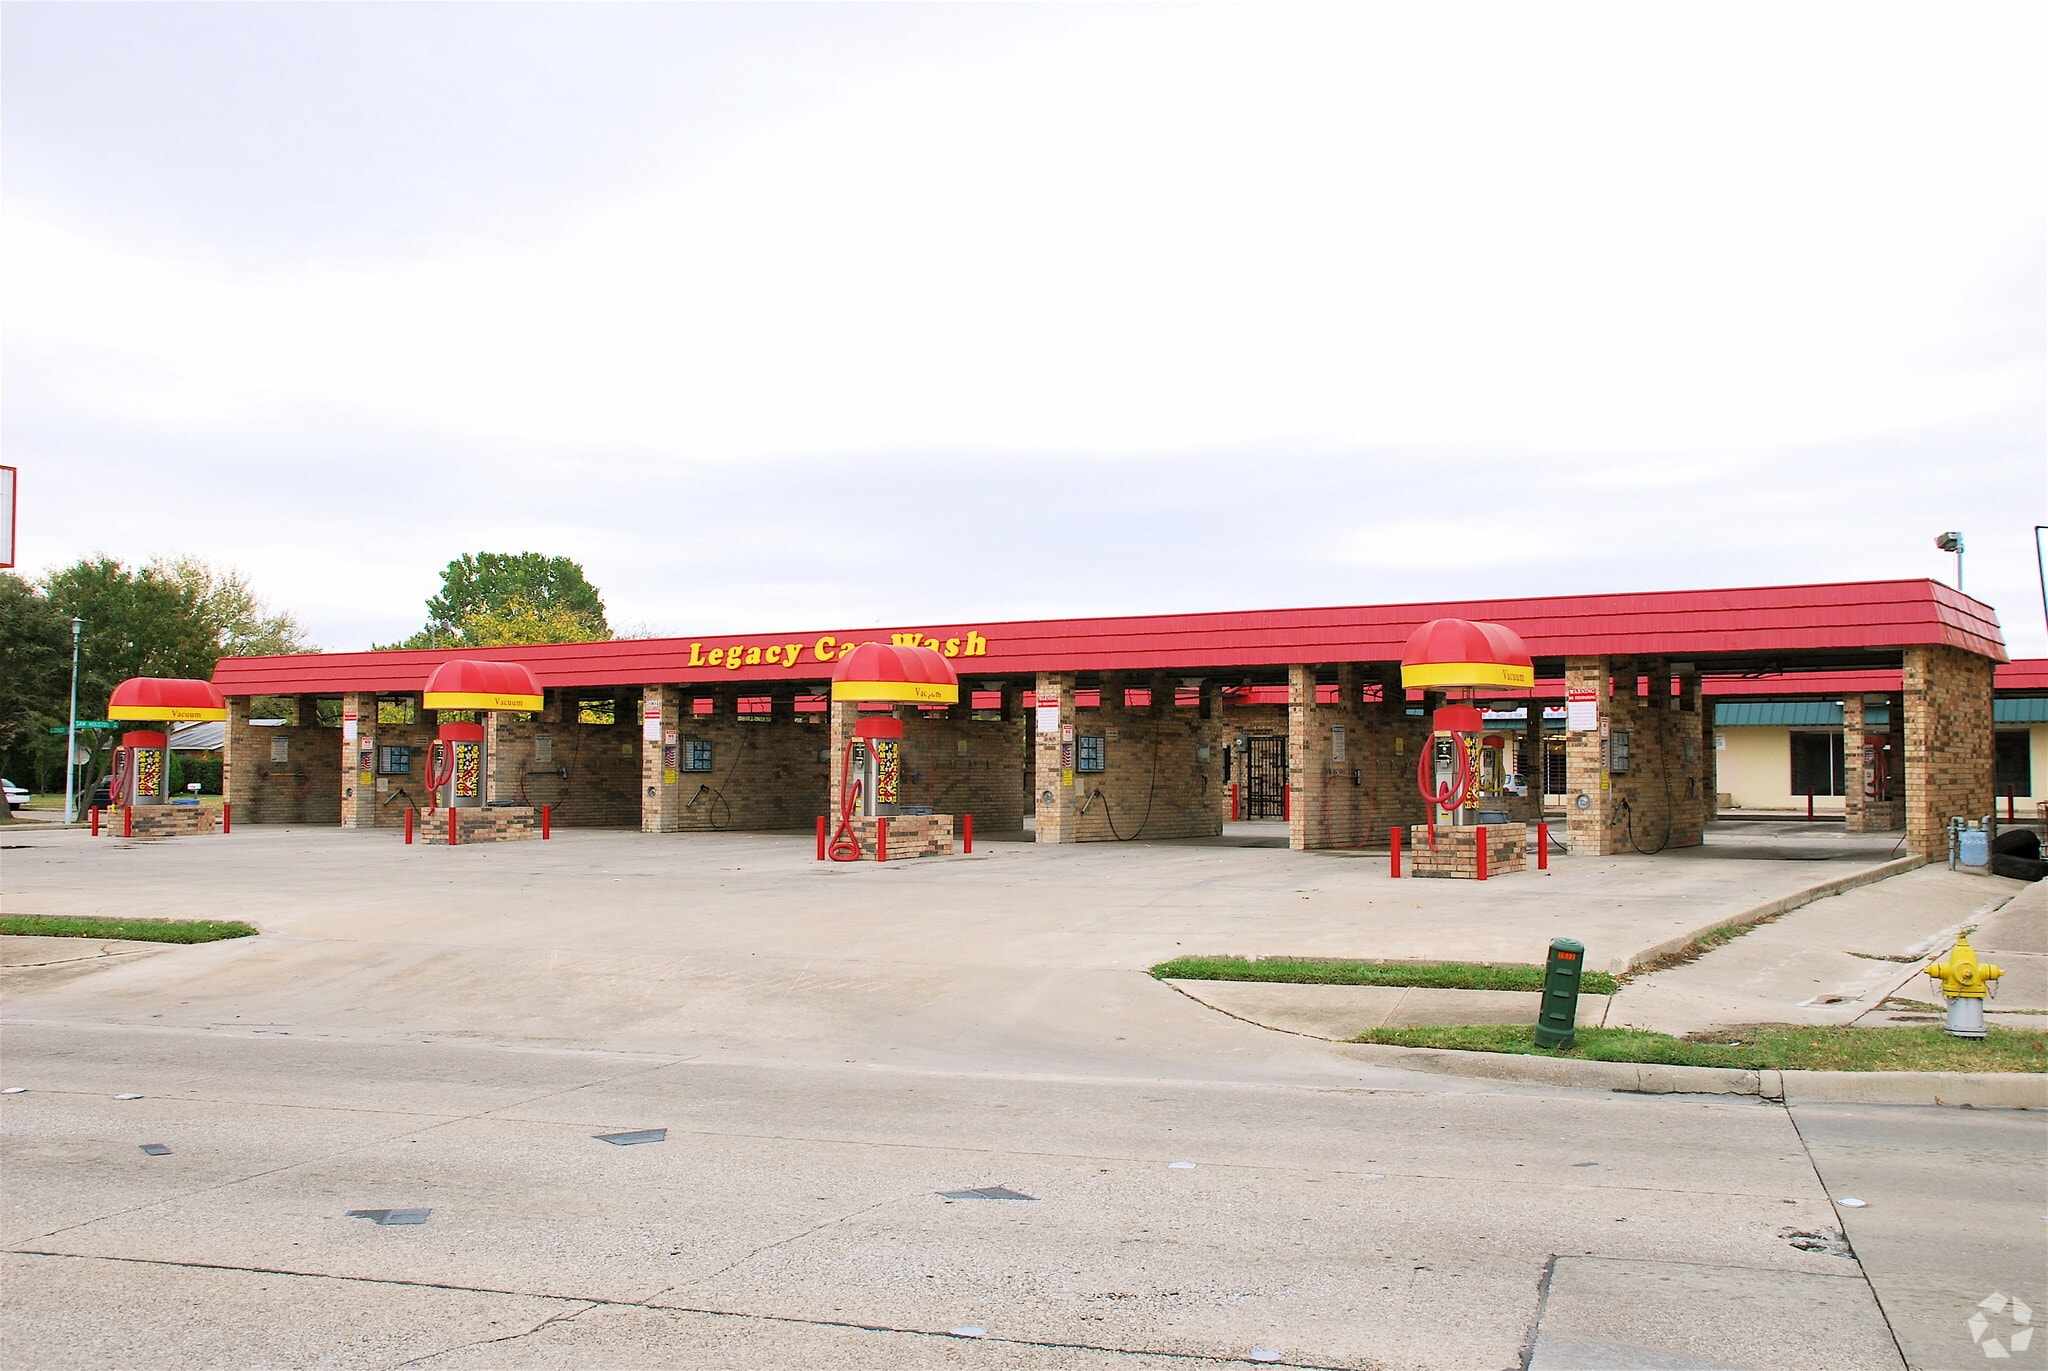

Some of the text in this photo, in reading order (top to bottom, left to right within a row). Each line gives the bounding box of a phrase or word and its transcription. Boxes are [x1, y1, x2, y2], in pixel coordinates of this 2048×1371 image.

[687, 642, 803, 670] Legacy
[814, 635, 877, 662] Ca
[1502, 669, 1525, 682] Vacuum
[494, 697, 524, 707] Vacuum
[171, 709, 202, 718] Vacuum
